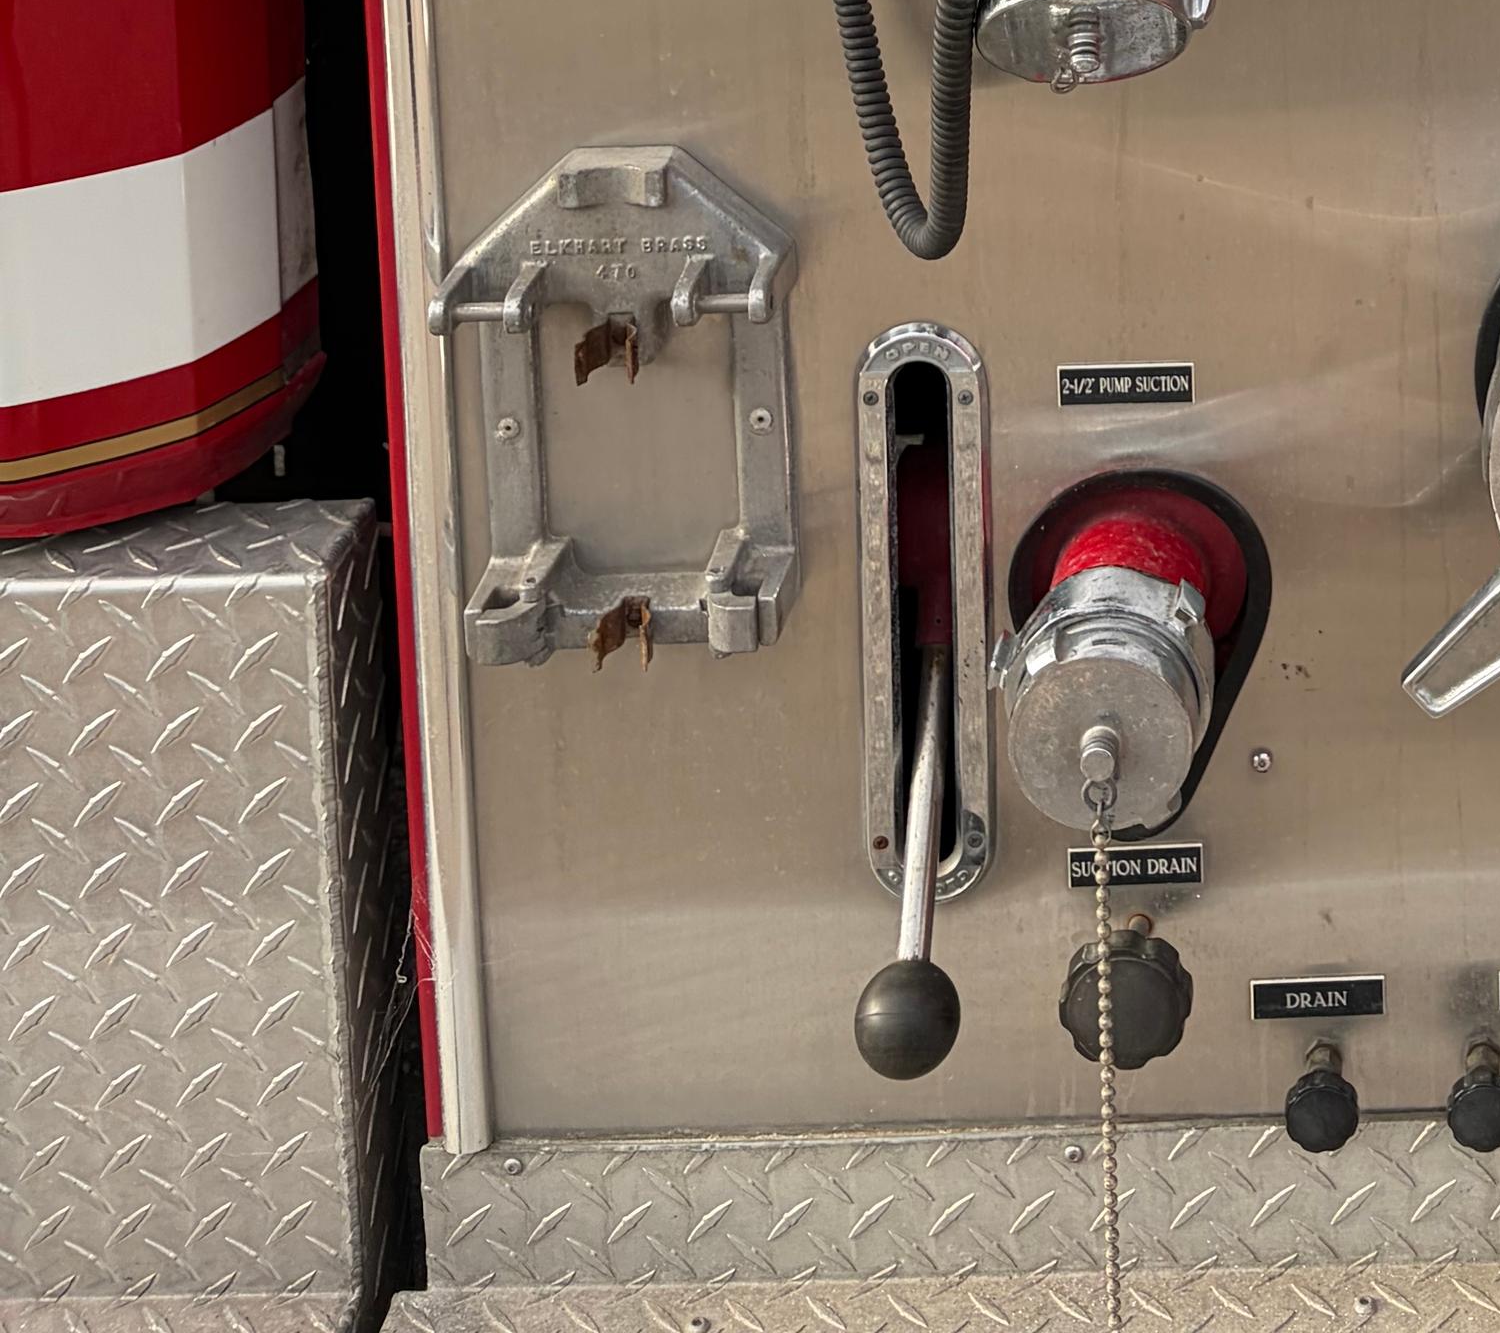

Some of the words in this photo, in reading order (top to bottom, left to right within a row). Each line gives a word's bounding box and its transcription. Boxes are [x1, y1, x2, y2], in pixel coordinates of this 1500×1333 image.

[530, 240, 627, 255] ELKHART
[640, 236, 709, 252] BRASS
[594, 266, 638, 280] 470
[1286, 990, 1348, 1009] DRAIN
